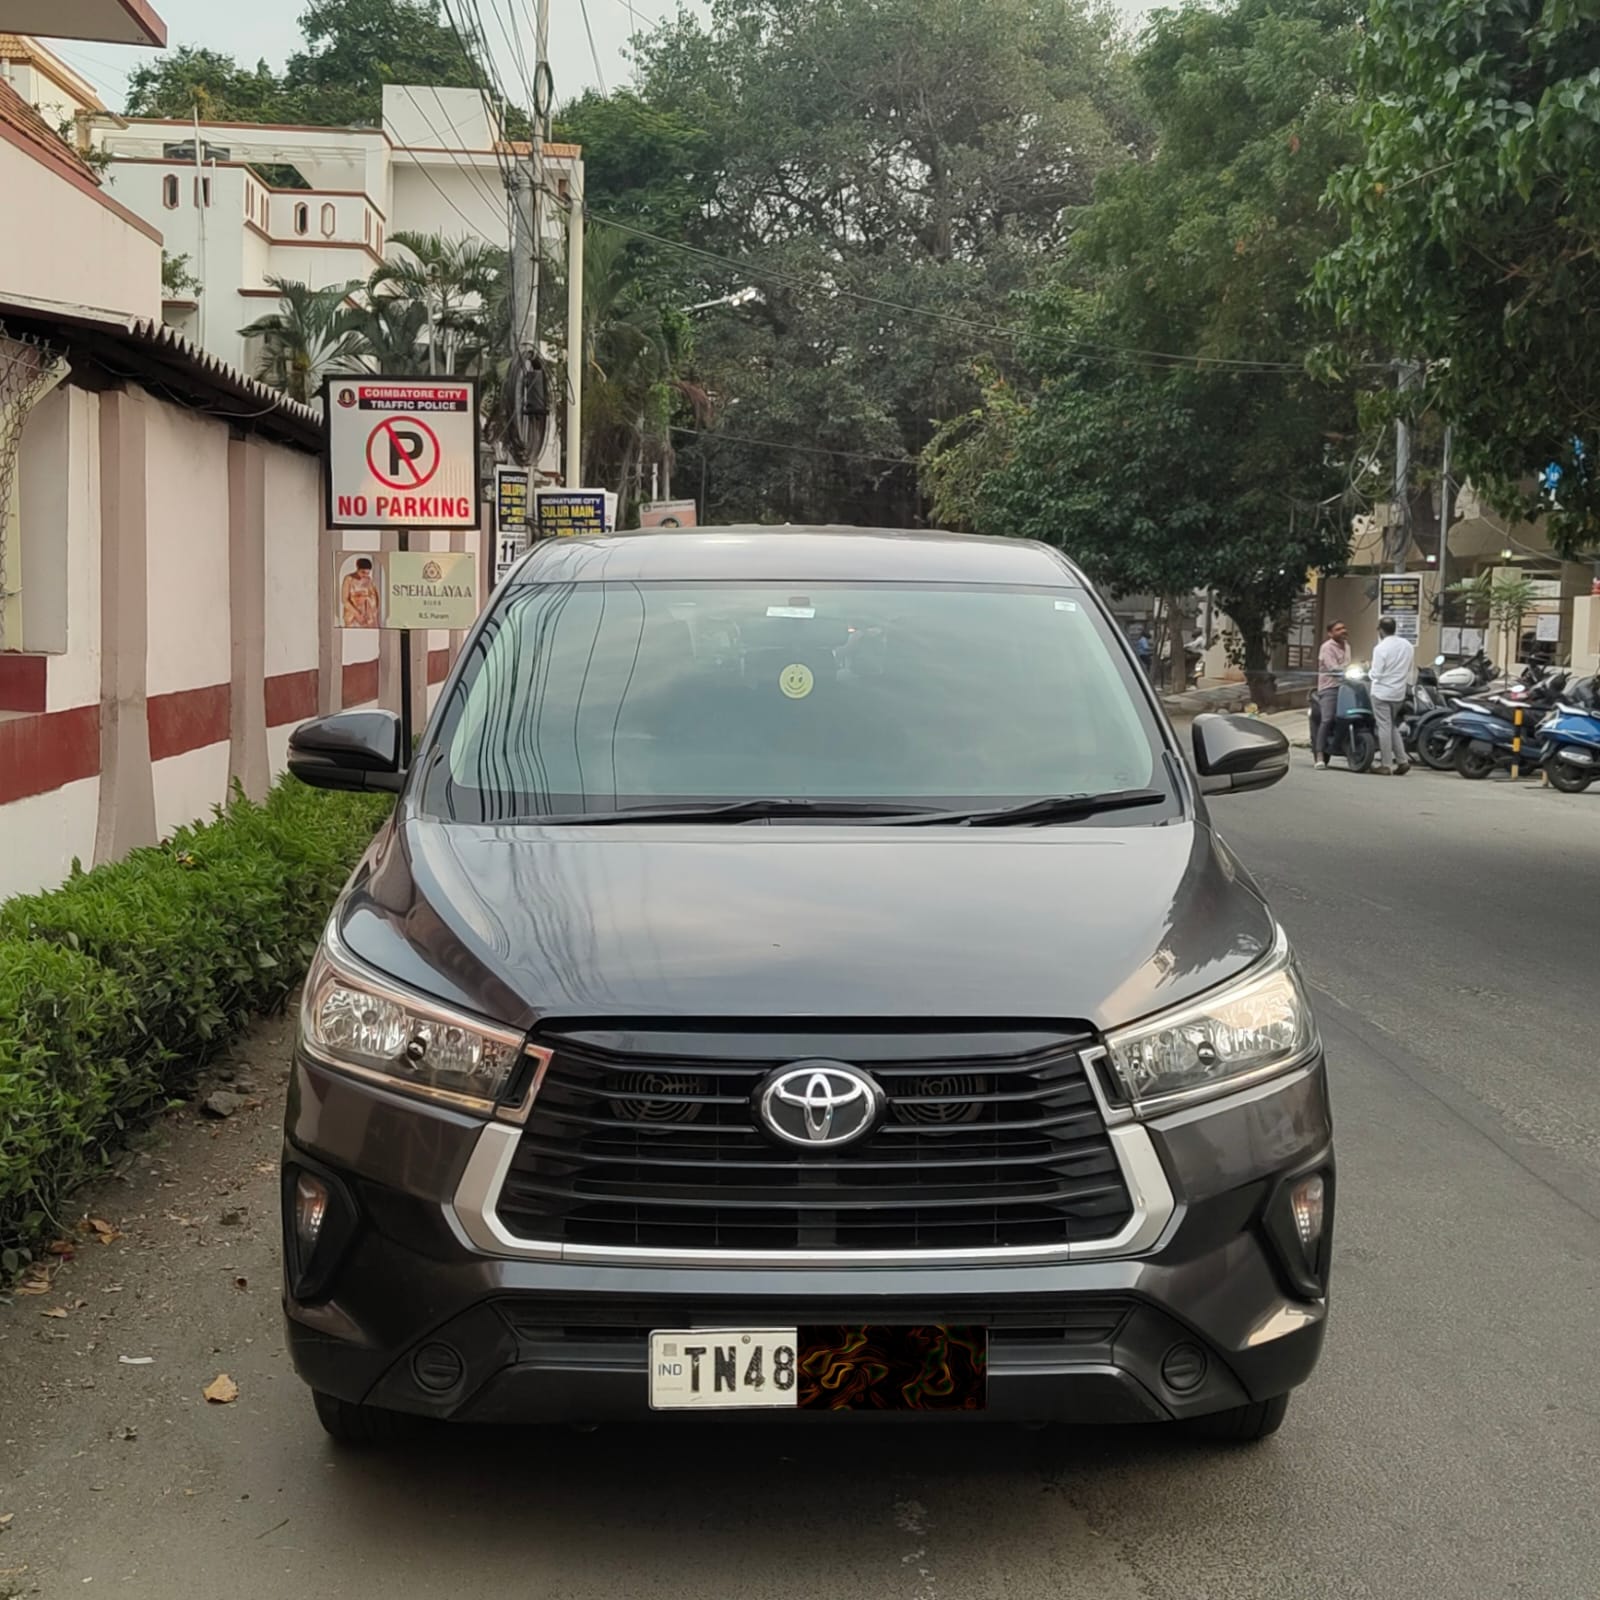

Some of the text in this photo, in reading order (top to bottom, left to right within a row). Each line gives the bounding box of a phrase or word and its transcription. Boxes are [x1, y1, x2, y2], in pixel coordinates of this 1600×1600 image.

[364, 388, 462, 399] COIMBATORE CITY
[370, 400, 456, 410] TRAFFIC POLICE
[389, 431, 424, 476] P
[338, 495, 469, 517] NO PARKING
[541, 505, 594, 518] SULUR MAIN
[392, 584, 472, 598] SNEHALAYAA
[658, 1345, 795, 1392] IND TN48
